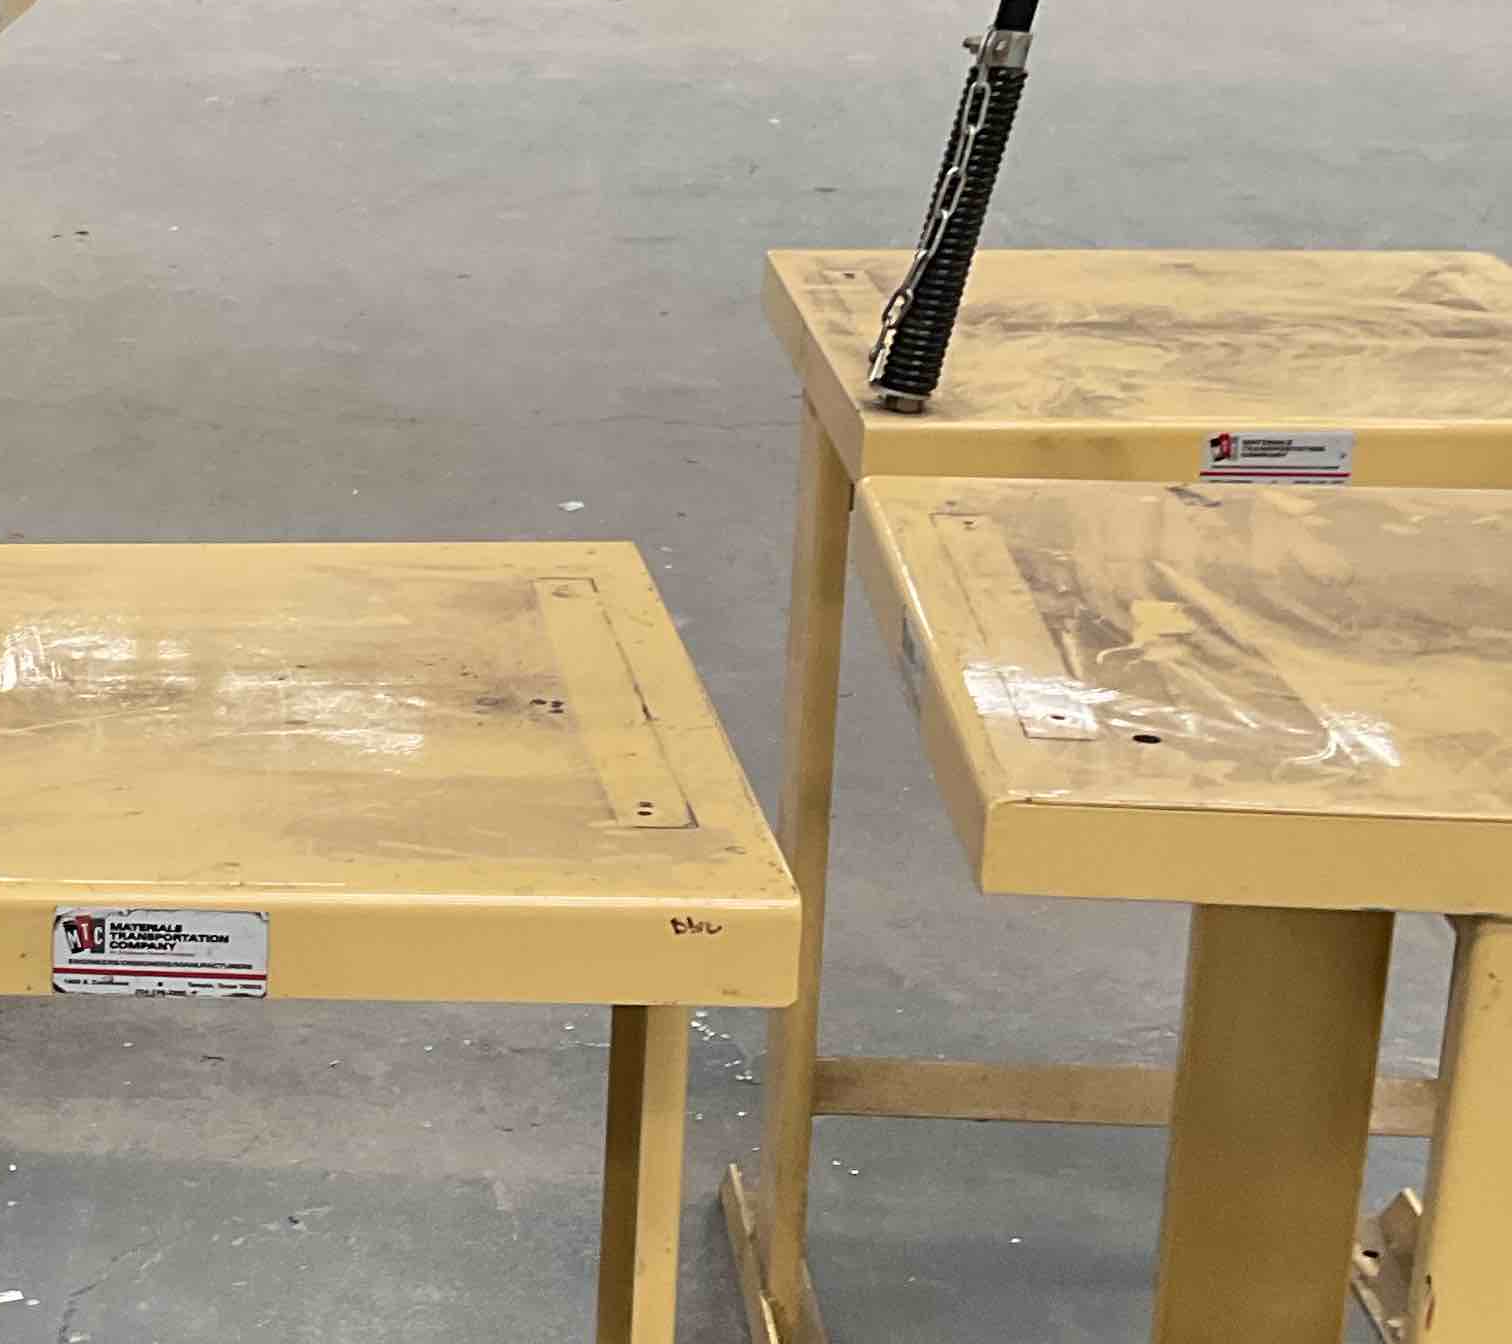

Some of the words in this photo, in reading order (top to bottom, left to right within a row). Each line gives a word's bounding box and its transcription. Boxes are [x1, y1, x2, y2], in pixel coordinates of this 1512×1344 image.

[65, 919, 105, 952] MTC
[109, 932, 230, 944] TRANSPORTATION
[109, 941, 177, 952] COMPANY
